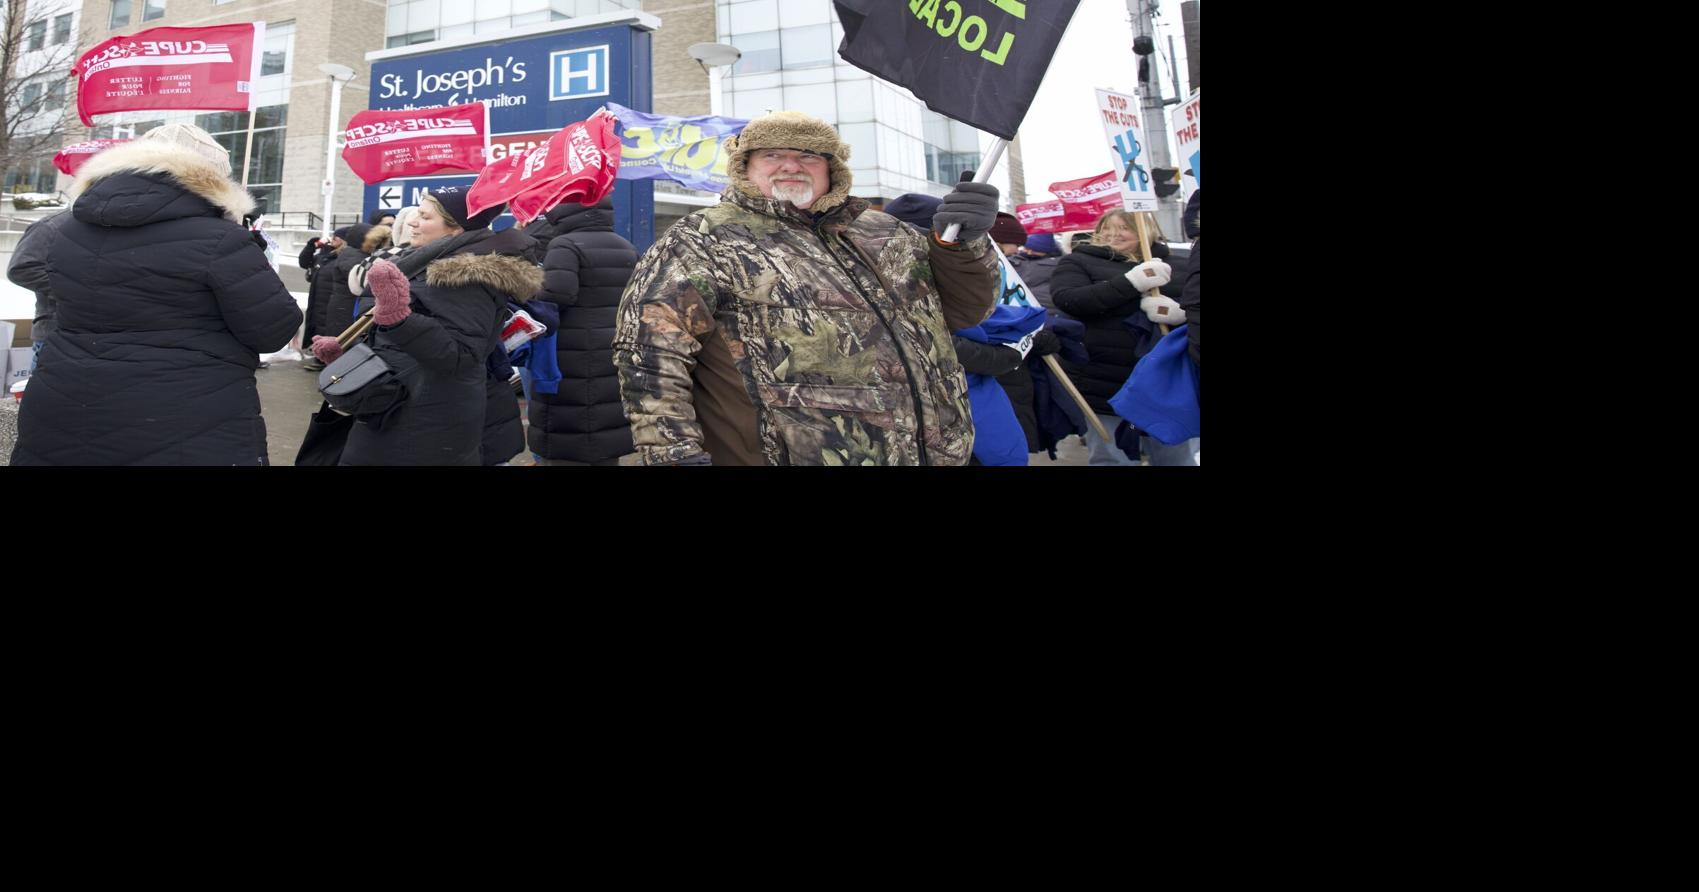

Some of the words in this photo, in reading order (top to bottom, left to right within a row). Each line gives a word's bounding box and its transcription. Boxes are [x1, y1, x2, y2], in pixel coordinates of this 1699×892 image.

[379, 73, 408, 99] St.
[414, 56, 527, 100] Joseph's
[560, 53, 598, 93] H
[1107, 95, 1128, 110] STOP
[1185, 98, 1200, 121] ST
[1102, 110, 1120, 125] THE
[1119, 112, 1139, 128] CUTS
[1176, 122, 1199, 145] THE
